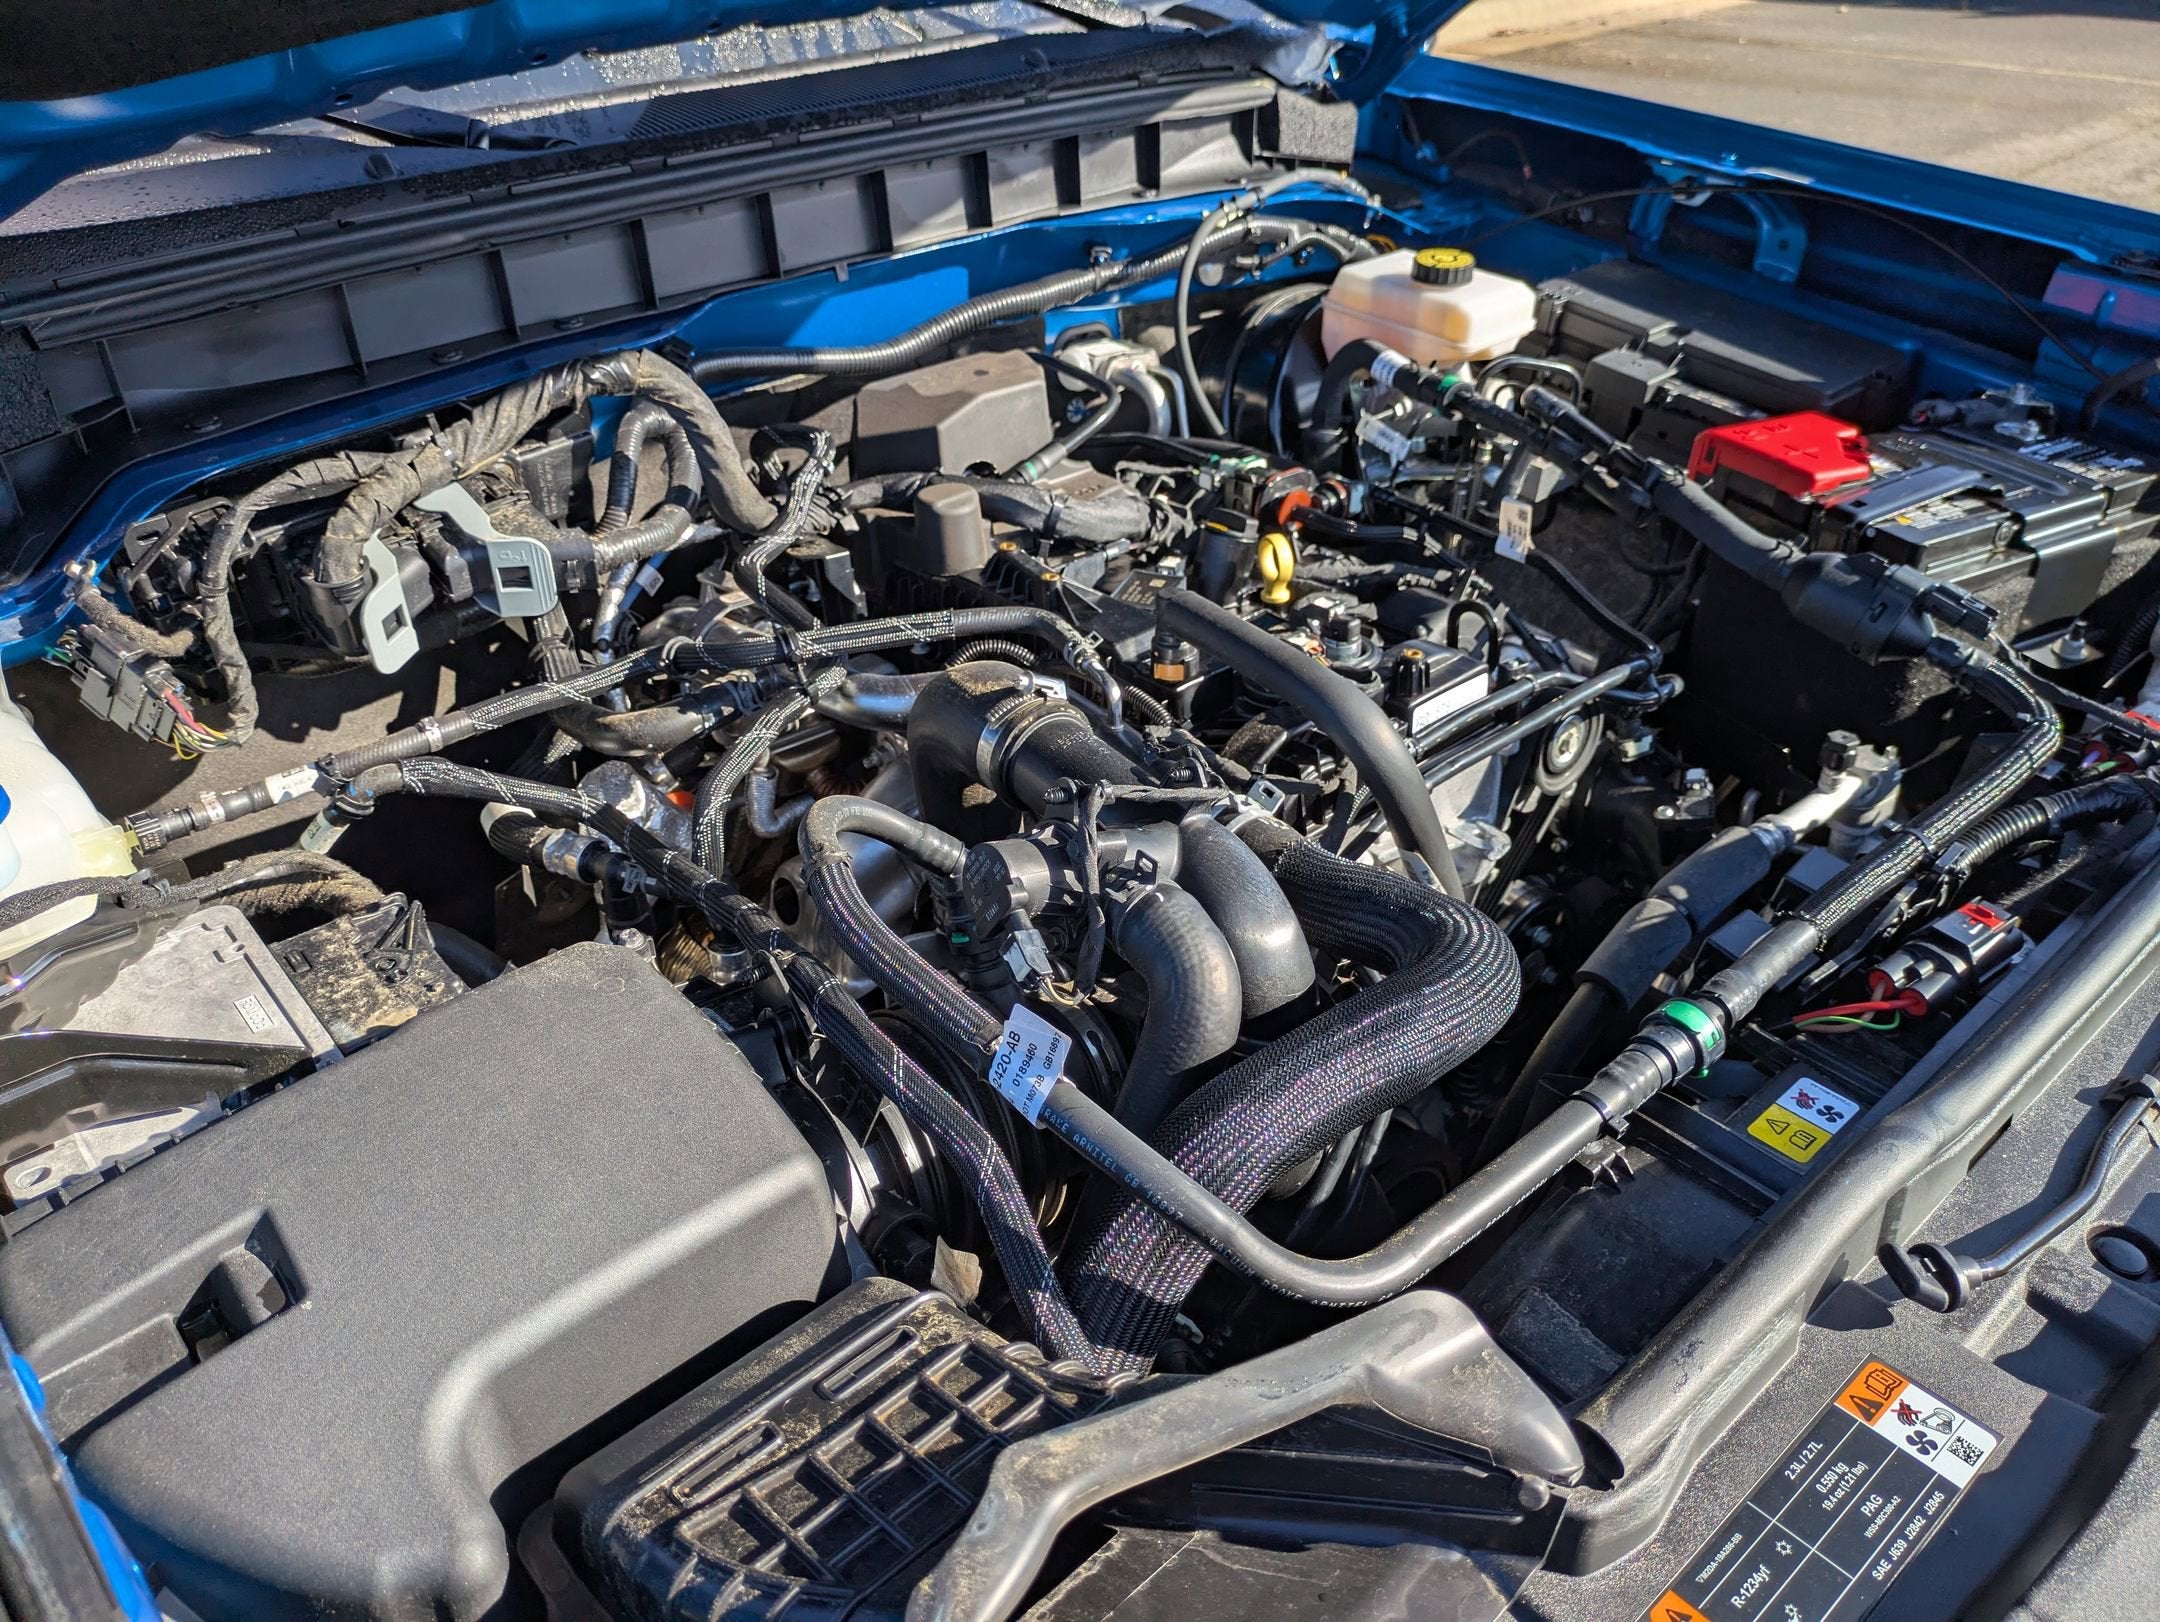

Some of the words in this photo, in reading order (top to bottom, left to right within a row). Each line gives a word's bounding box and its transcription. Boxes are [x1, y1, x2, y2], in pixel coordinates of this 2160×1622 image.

[992, 1030, 1021, 1090] 2420-AB
[1012, 1042, 1038, 1088] 0189460
[1042, 1031, 1062, 1071] GB16897
[1784, 1460, 1806, 1481] 2.3L
[1802, 1440, 1824, 1461] 2.7L
[1816, 1470, 1839, 1494] 0.550
[1831, 1461, 1850, 1476] kg
[1850, 1460, 1870, 1477] lbs)
[1834, 1487, 1846, 1500] oz
[1839, 1474, 1857, 1493] (1.21
[1821, 1494, 1839, 1512] 19.4
[1860, 1493, 1883, 1517] PAG
[1871, 1559, 1893, 1581] SAE
[1887, 1538, 1908, 1561] J639
[1904, 1515, 1927, 1540] J2842
[1923, 1490, 1946, 1516] J2845
[1730, 1563, 1771, 1609] R-1234yf
